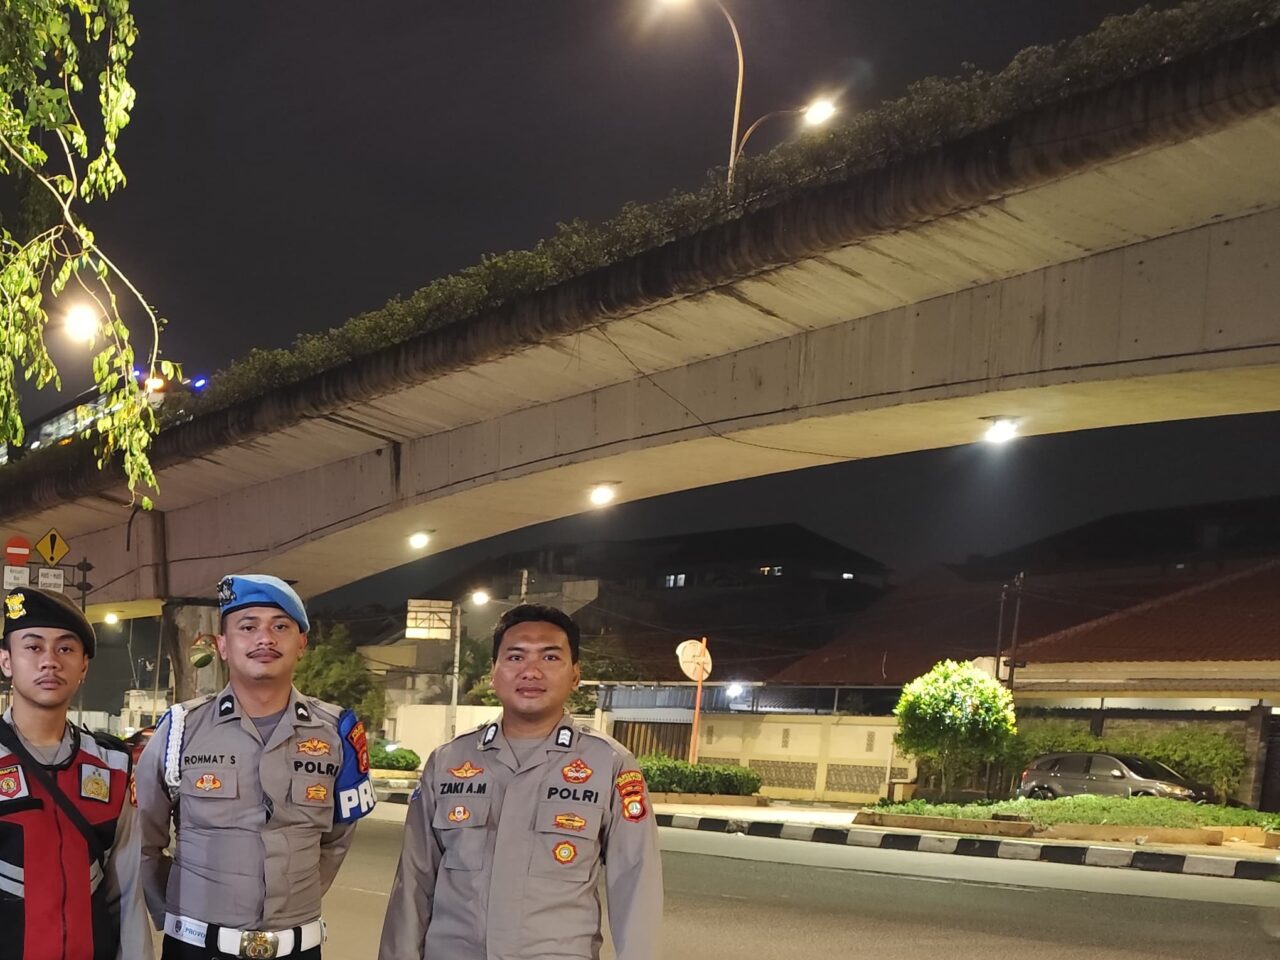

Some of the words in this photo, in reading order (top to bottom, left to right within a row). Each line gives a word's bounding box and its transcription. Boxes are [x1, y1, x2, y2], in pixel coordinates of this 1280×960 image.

[184, 755, 224, 765] ROHMAT
[230, 755, 236, 765] S
[293, 761, 339, 777] POLRI
[440, 782, 464, 795] ZAKI
[465, 783, 487, 795] A.M
[547, 787, 599, 804] POLRI
